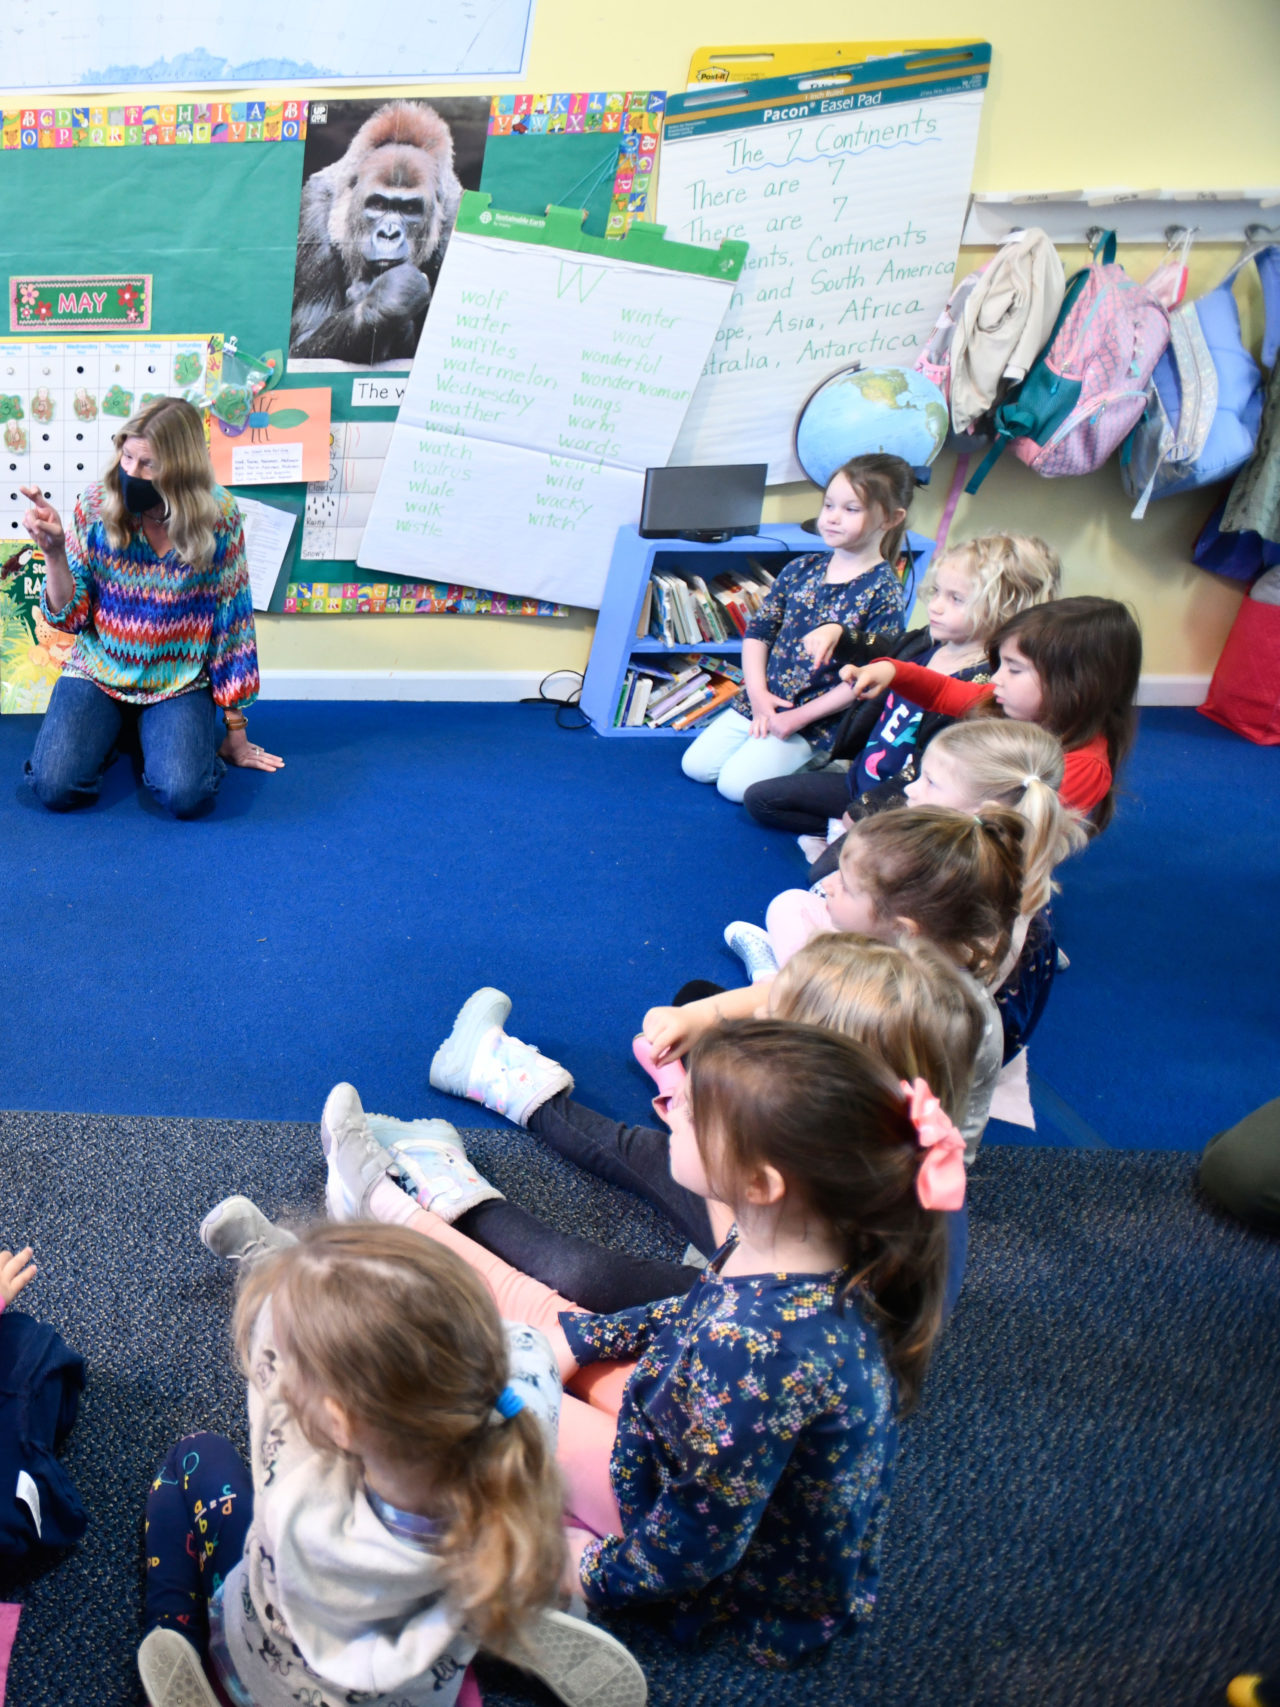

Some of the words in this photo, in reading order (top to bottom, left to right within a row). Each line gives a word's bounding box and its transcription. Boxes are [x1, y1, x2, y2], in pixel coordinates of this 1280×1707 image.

[700, 73, 726, 82] Post-it
[820, 94, 854, 114] Easel
[858, 91, 882, 109] Pad
[723, 138, 765, 167] The
[786, 127, 804, 162] 7
[815, 108, 937, 153] Continents
[684, 179, 748, 211] There
[763, 177, 801, 198] are
[828, 159, 846, 186] 7
[529, 216, 547, 228] Earth
[681, 215, 747, 243] There
[766, 214, 803, 233] are
[832, 195, 849, 223] 7
[805, 221, 927, 263] Continents
[556, 260, 608, 304] W
[756, 277, 794, 303] and
[810, 265, 865, 296] South
[876, 258, 957, 287] America
[57, 291, 108, 314] MAY
[461, 288, 509, 311] wolf
[838, 296, 925, 326] Africa
[456, 313, 512, 335] water
[621, 307, 682, 329] winter
[450, 335, 518, 360] waffles
[796, 331, 919, 365] Antarctica
[442, 357, 558, 390] watermelon
[581, 349, 663, 376] wonderful
[358, 382, 390, 400] The
[436, 373, 536, 417] Wednesday
[429, 399, 507, 423] weather
[572, 392, 622, 421] wings
[568, 413, 616, 434] worm
[419, 440, 473, 460] watch
[558, 433, 622, 457] words
[408, 478, 456, 498] whale
[546, 473, 585, 492] wild
[405, 500, 446, 518] walk
[536, 492, 594, 521] wacky
[528, 512, 576, 531] witch
